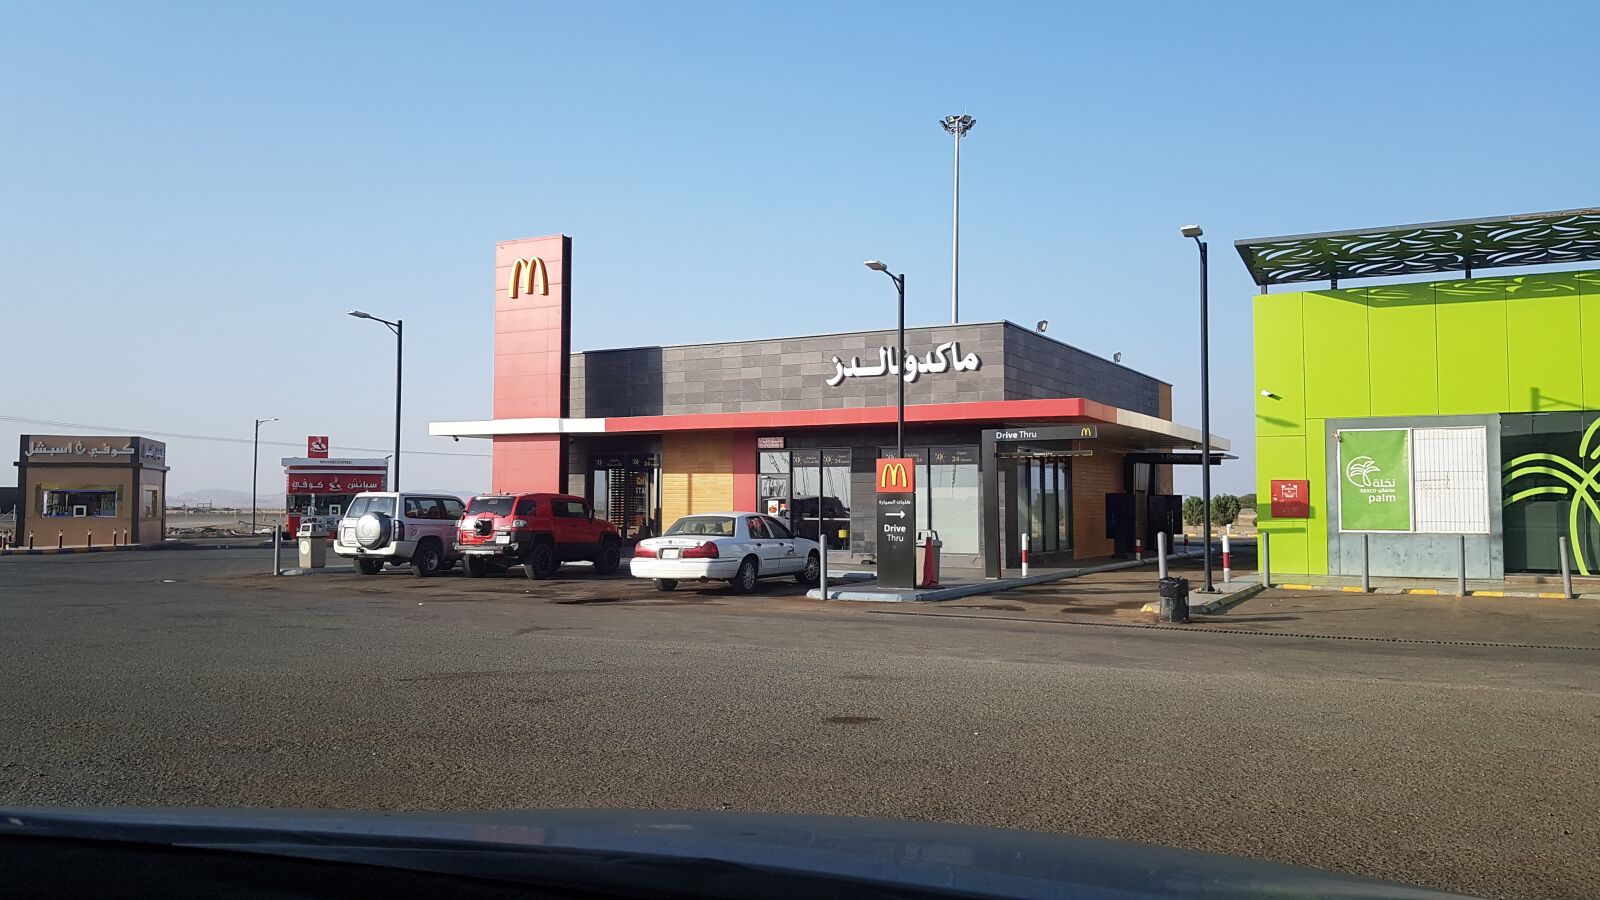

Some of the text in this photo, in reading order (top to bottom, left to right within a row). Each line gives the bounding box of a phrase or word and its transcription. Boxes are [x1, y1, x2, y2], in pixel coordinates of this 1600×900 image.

[826, 341, 981, 386] ماكدوالدز
[995, 430, 1037, 439] Drive Thru
[87, 442, 135, 457] كوفي
[1373, 478, 1396, 487] نخلة
[1369, 493, 1396, 504] palm
[883, 524, 906, 533] Drive
[886, 533, 904, 542] Thru
